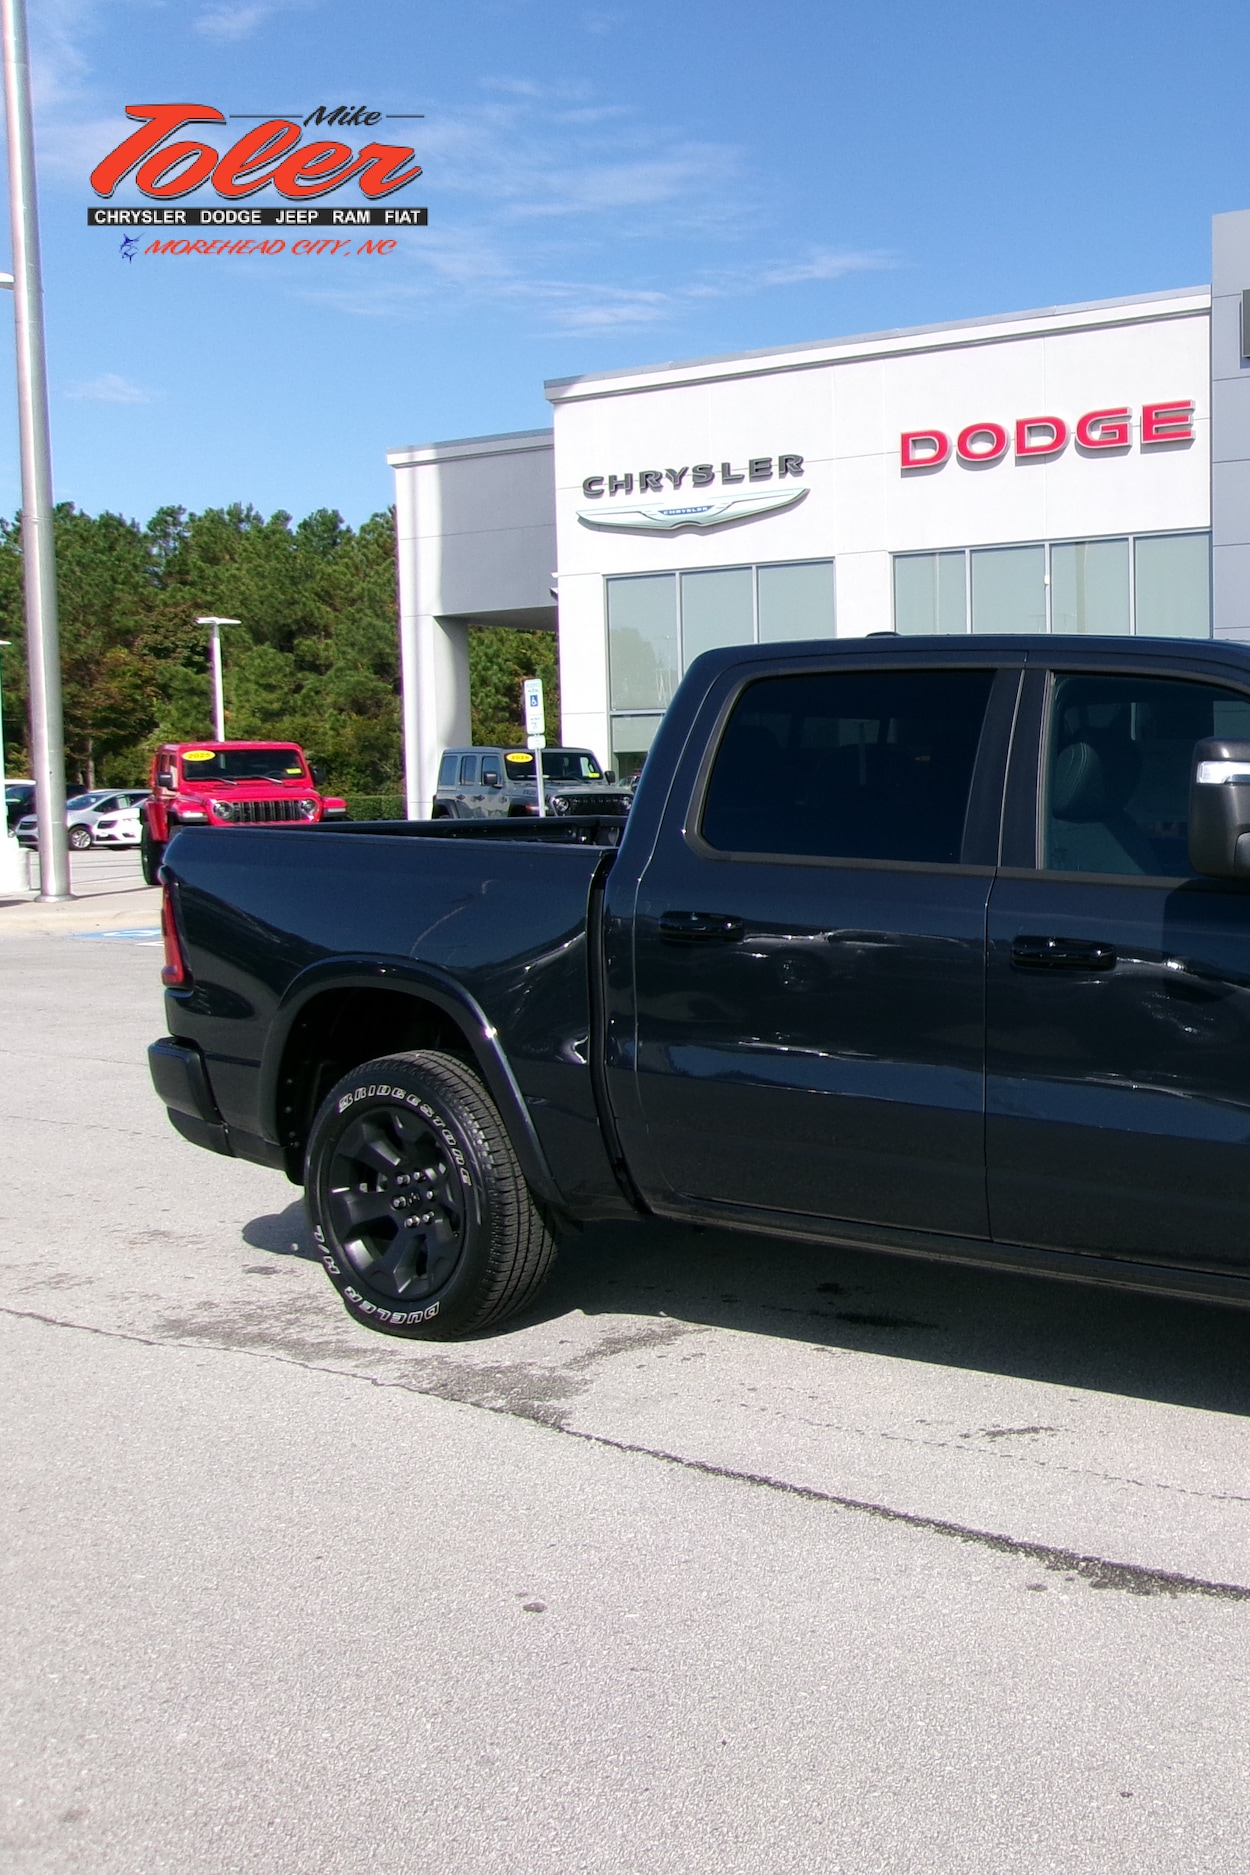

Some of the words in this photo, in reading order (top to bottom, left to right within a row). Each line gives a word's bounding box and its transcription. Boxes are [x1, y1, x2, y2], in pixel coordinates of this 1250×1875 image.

[899, 399, 1197, 477] DODGE
[582, 453, 805, 498] CHRYSLER
[663, 506, 709, 516] CHRYSLER
[339, 1084, 472, 1187] BRIDGESTONE
[344, 1285, 440, 1325] DUELER
